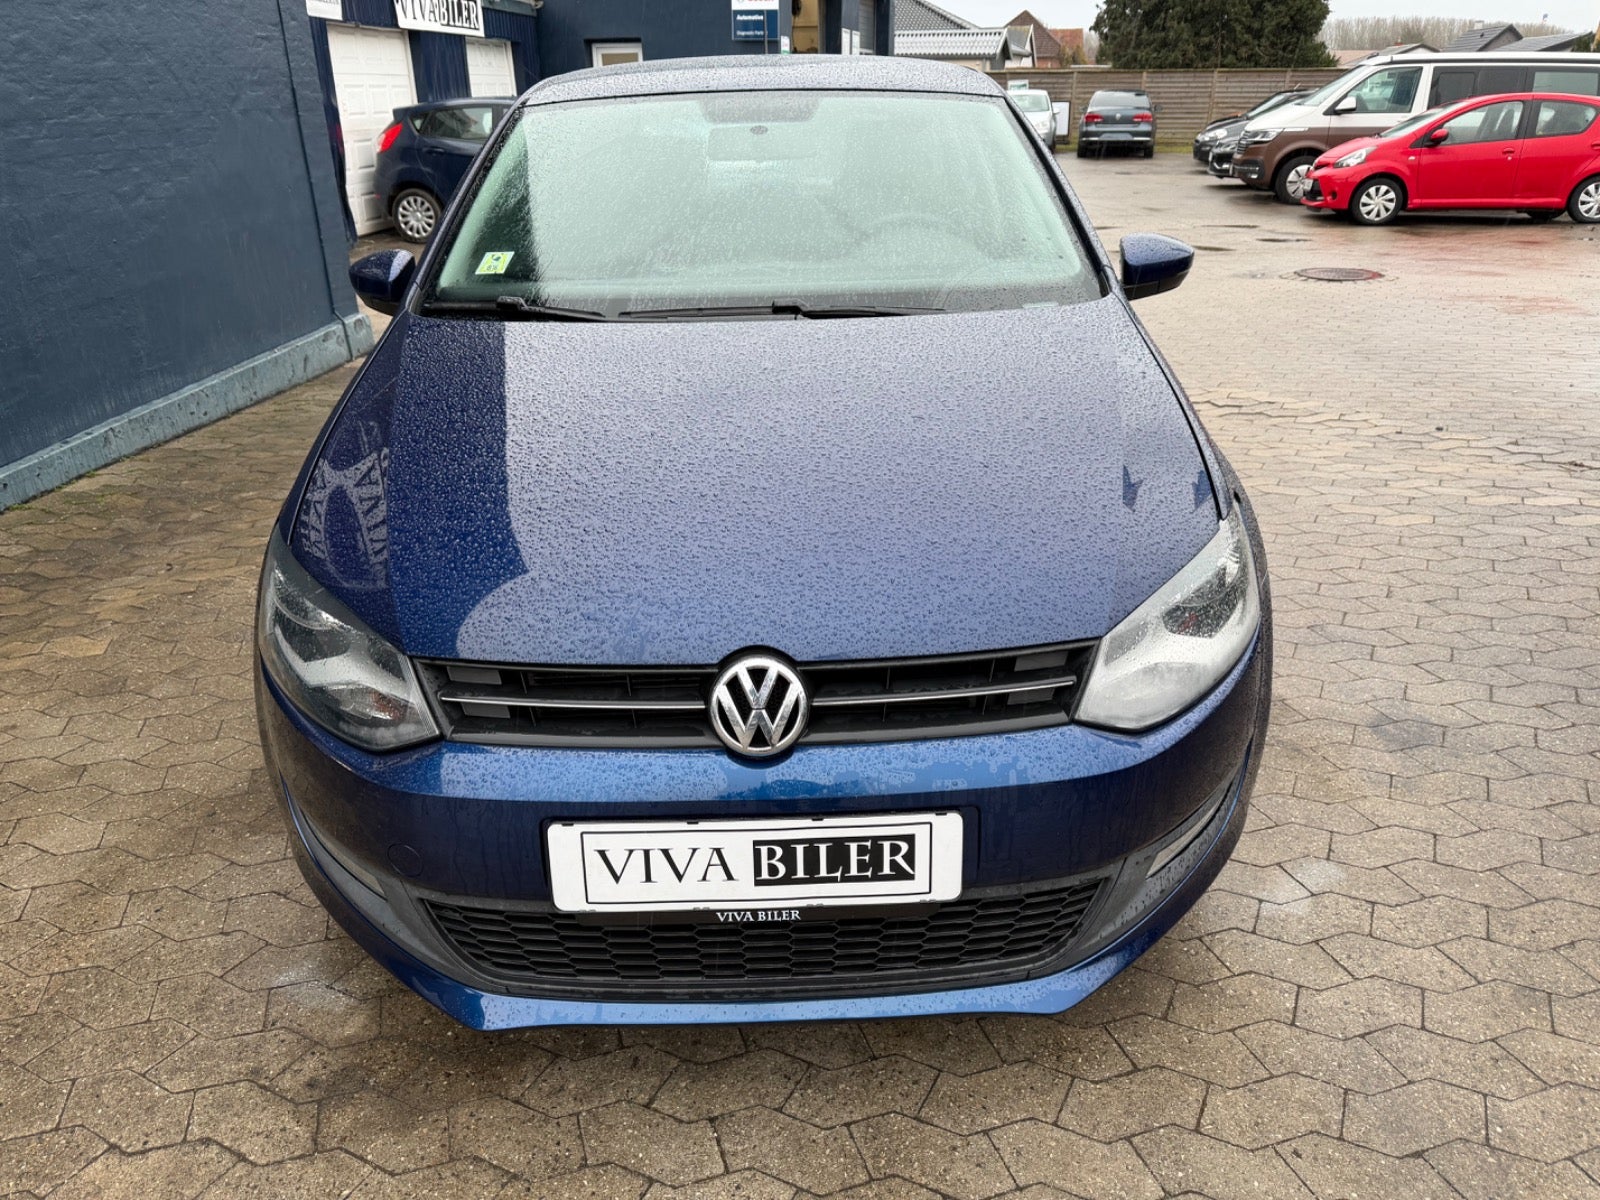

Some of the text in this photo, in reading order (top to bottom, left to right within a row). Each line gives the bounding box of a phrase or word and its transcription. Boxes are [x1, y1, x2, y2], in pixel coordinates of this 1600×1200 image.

[399, 0, 479, 29] VIVA BILER
[594, 839, 915, 884] VIVA BILER
[716, 909, 802, 922] VIVA BILER
